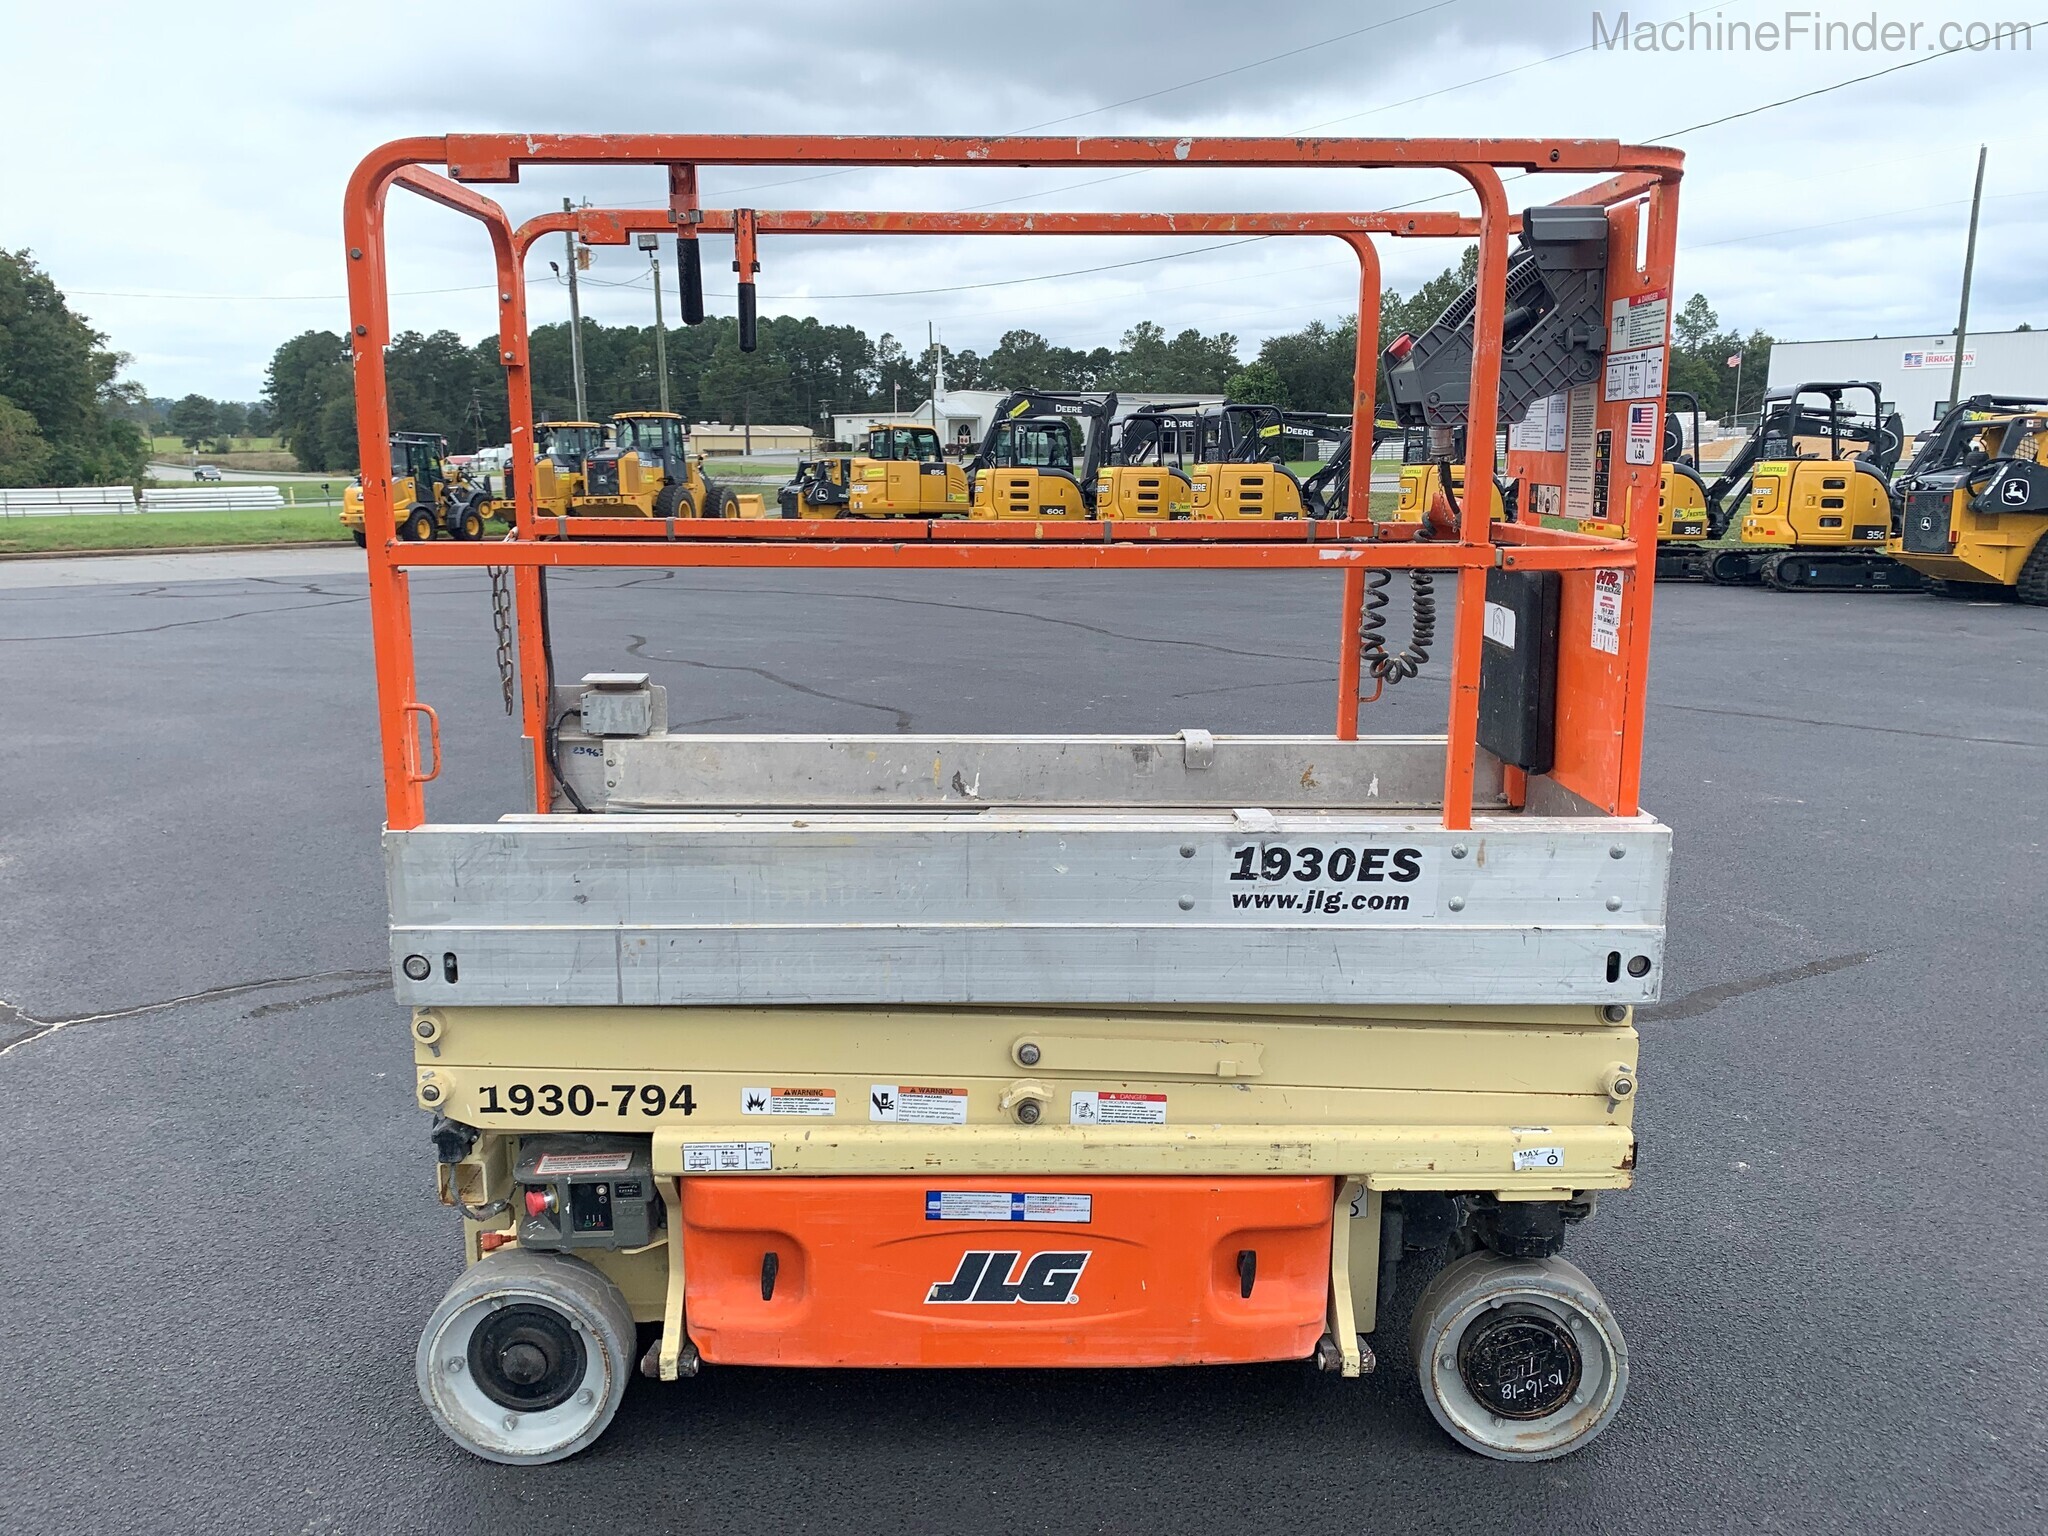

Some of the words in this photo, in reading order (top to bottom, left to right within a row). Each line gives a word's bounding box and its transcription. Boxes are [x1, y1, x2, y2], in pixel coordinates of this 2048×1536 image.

[1641, 291, 1659, 303] DANGER
[1925, 354, 1975, 363] IRRIGAON
[1055, 404, 1083, 414] DEERE
[1286, 426, 1315, 437] DEERE
[1634, 449, 1645, 460] USA
[1684, 526, 1701, 535] 35G
[1866, 530, 1885, 540] 35G
[1596, 570, 1619, 587] HR
[1229, 846, 1423, 883] 1930ES
[1232, 889, 1410, 915] www.jlg.com
[478, 1083, 698, 1117] 1930-794
[1519, 1149, 1539, 1159] MAX
[922, 1249, 1094, 1305] JLG
